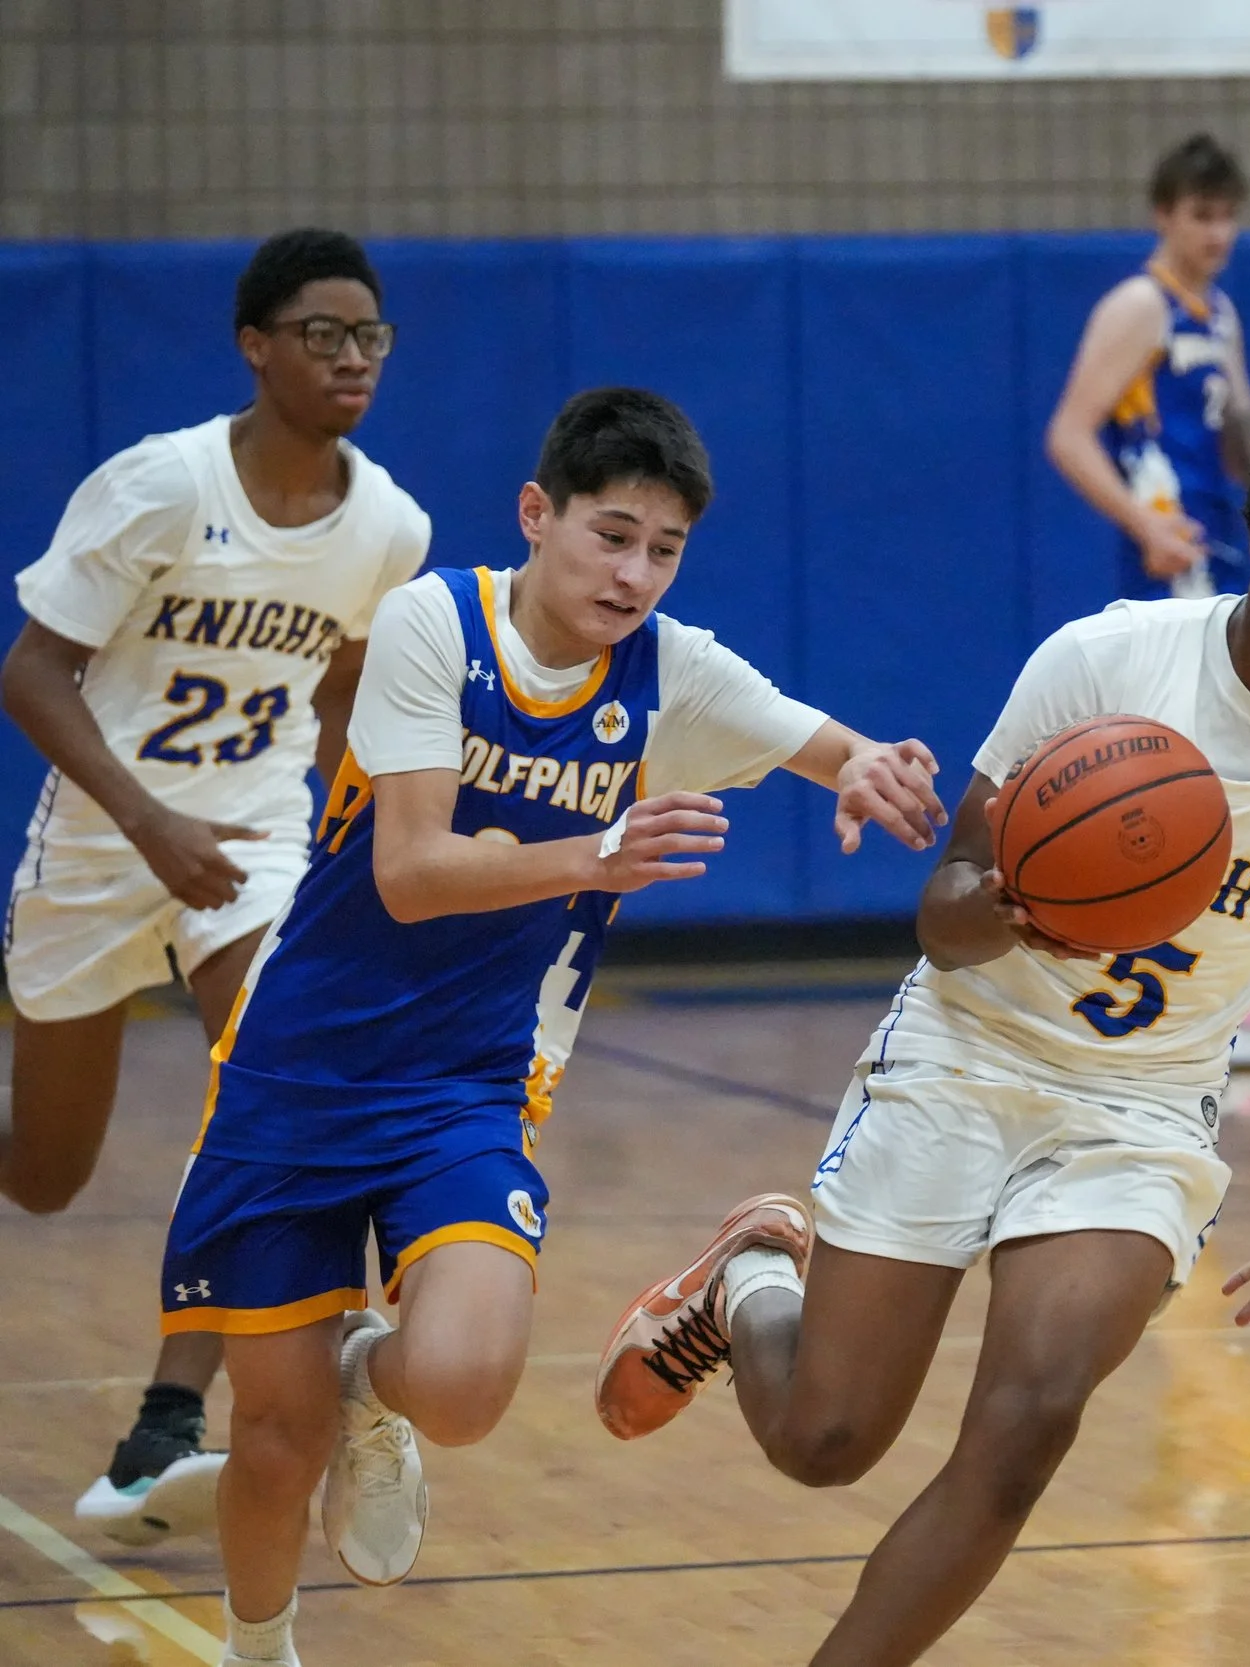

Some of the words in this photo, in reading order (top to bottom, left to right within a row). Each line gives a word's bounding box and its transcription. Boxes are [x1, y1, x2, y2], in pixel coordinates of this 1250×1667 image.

[136, 667, 290, 768] 23
[459, 728, 638, 824] OLFPACK
[1036, 736, 1169, 808] EVOLUTION
[1069, 941, 1204, 1041] 5
